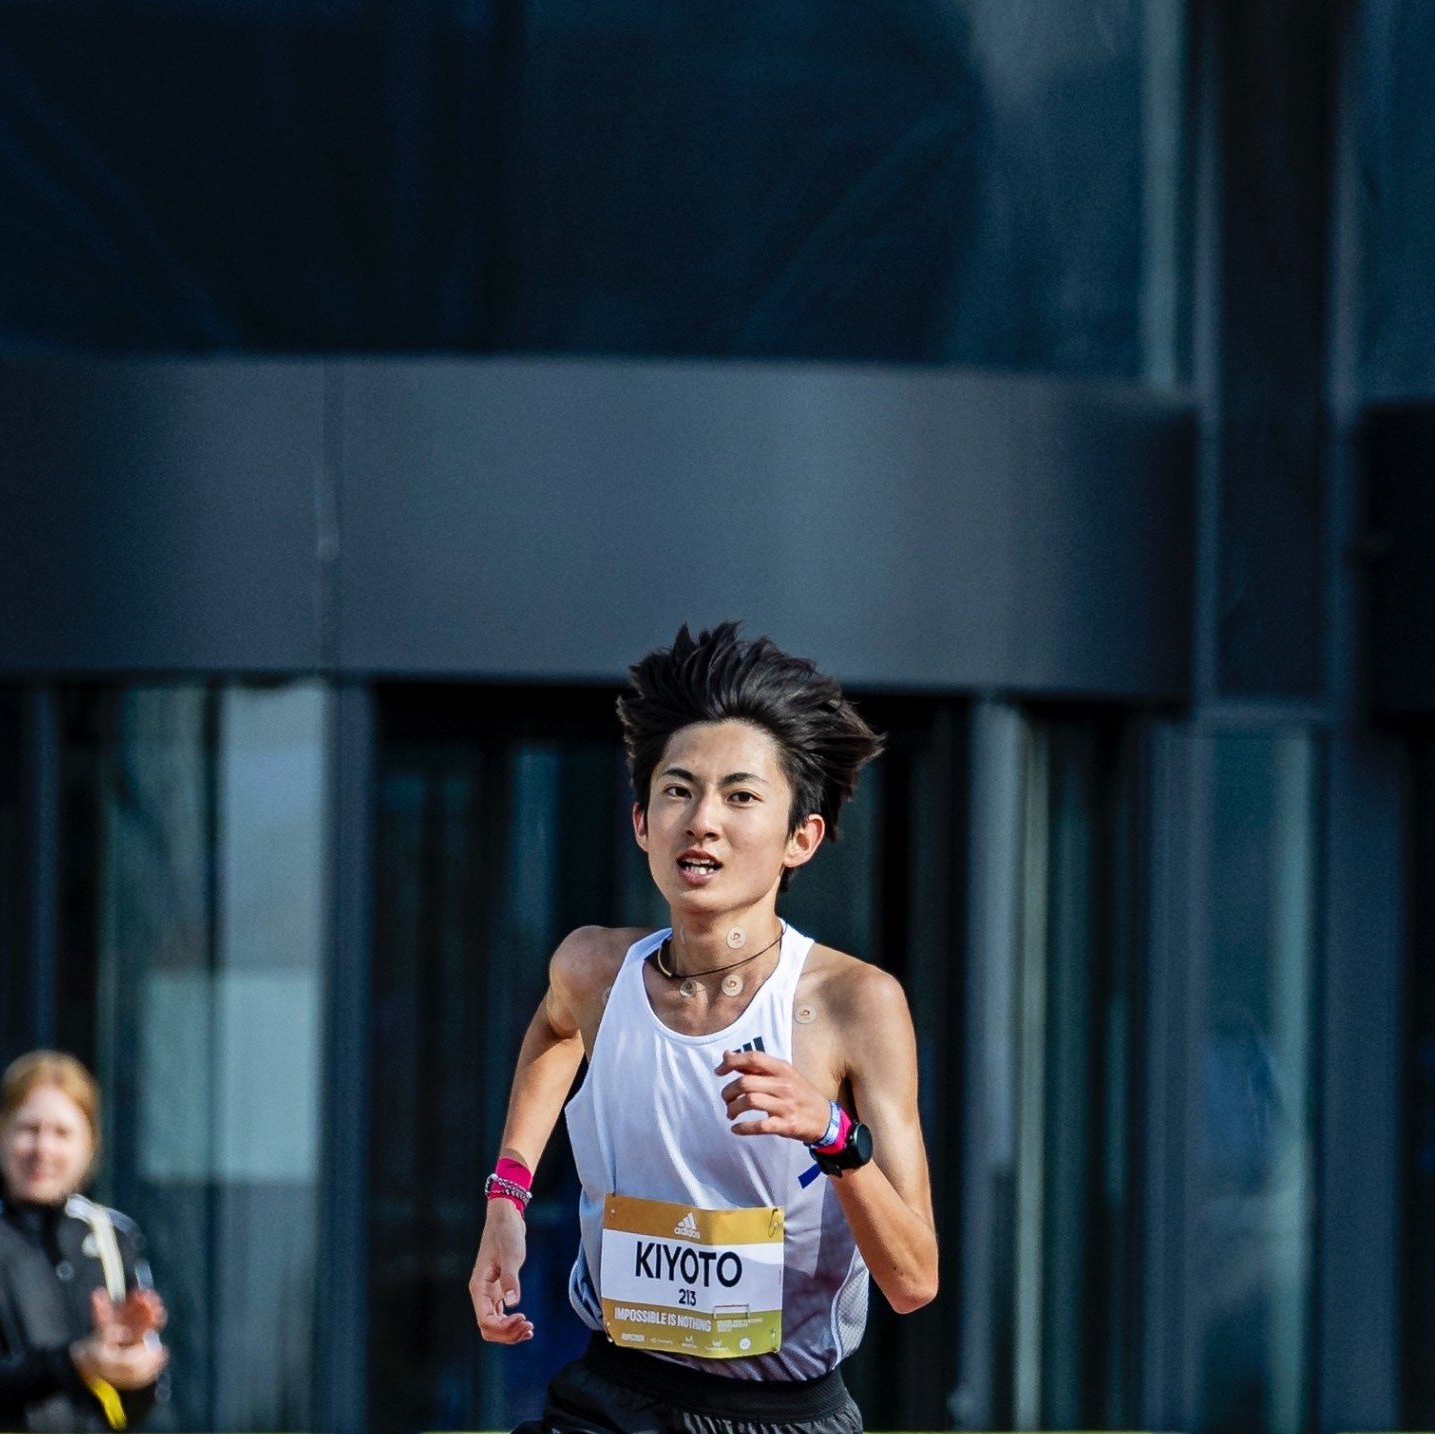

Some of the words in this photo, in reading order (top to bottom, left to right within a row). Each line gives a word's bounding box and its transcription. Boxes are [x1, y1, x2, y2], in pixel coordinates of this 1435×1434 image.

[673, 1226, 701, 1240] adidas
[635, 1240, 743, 1288] KIYOTO
[678, 1288, 697, 1306] 213
[614, 1307, 667, 1325] IMPOSSIBLE
[667, 1313, 677, 1327] IS
[677, 1315, 712, 1333] NOTHING
